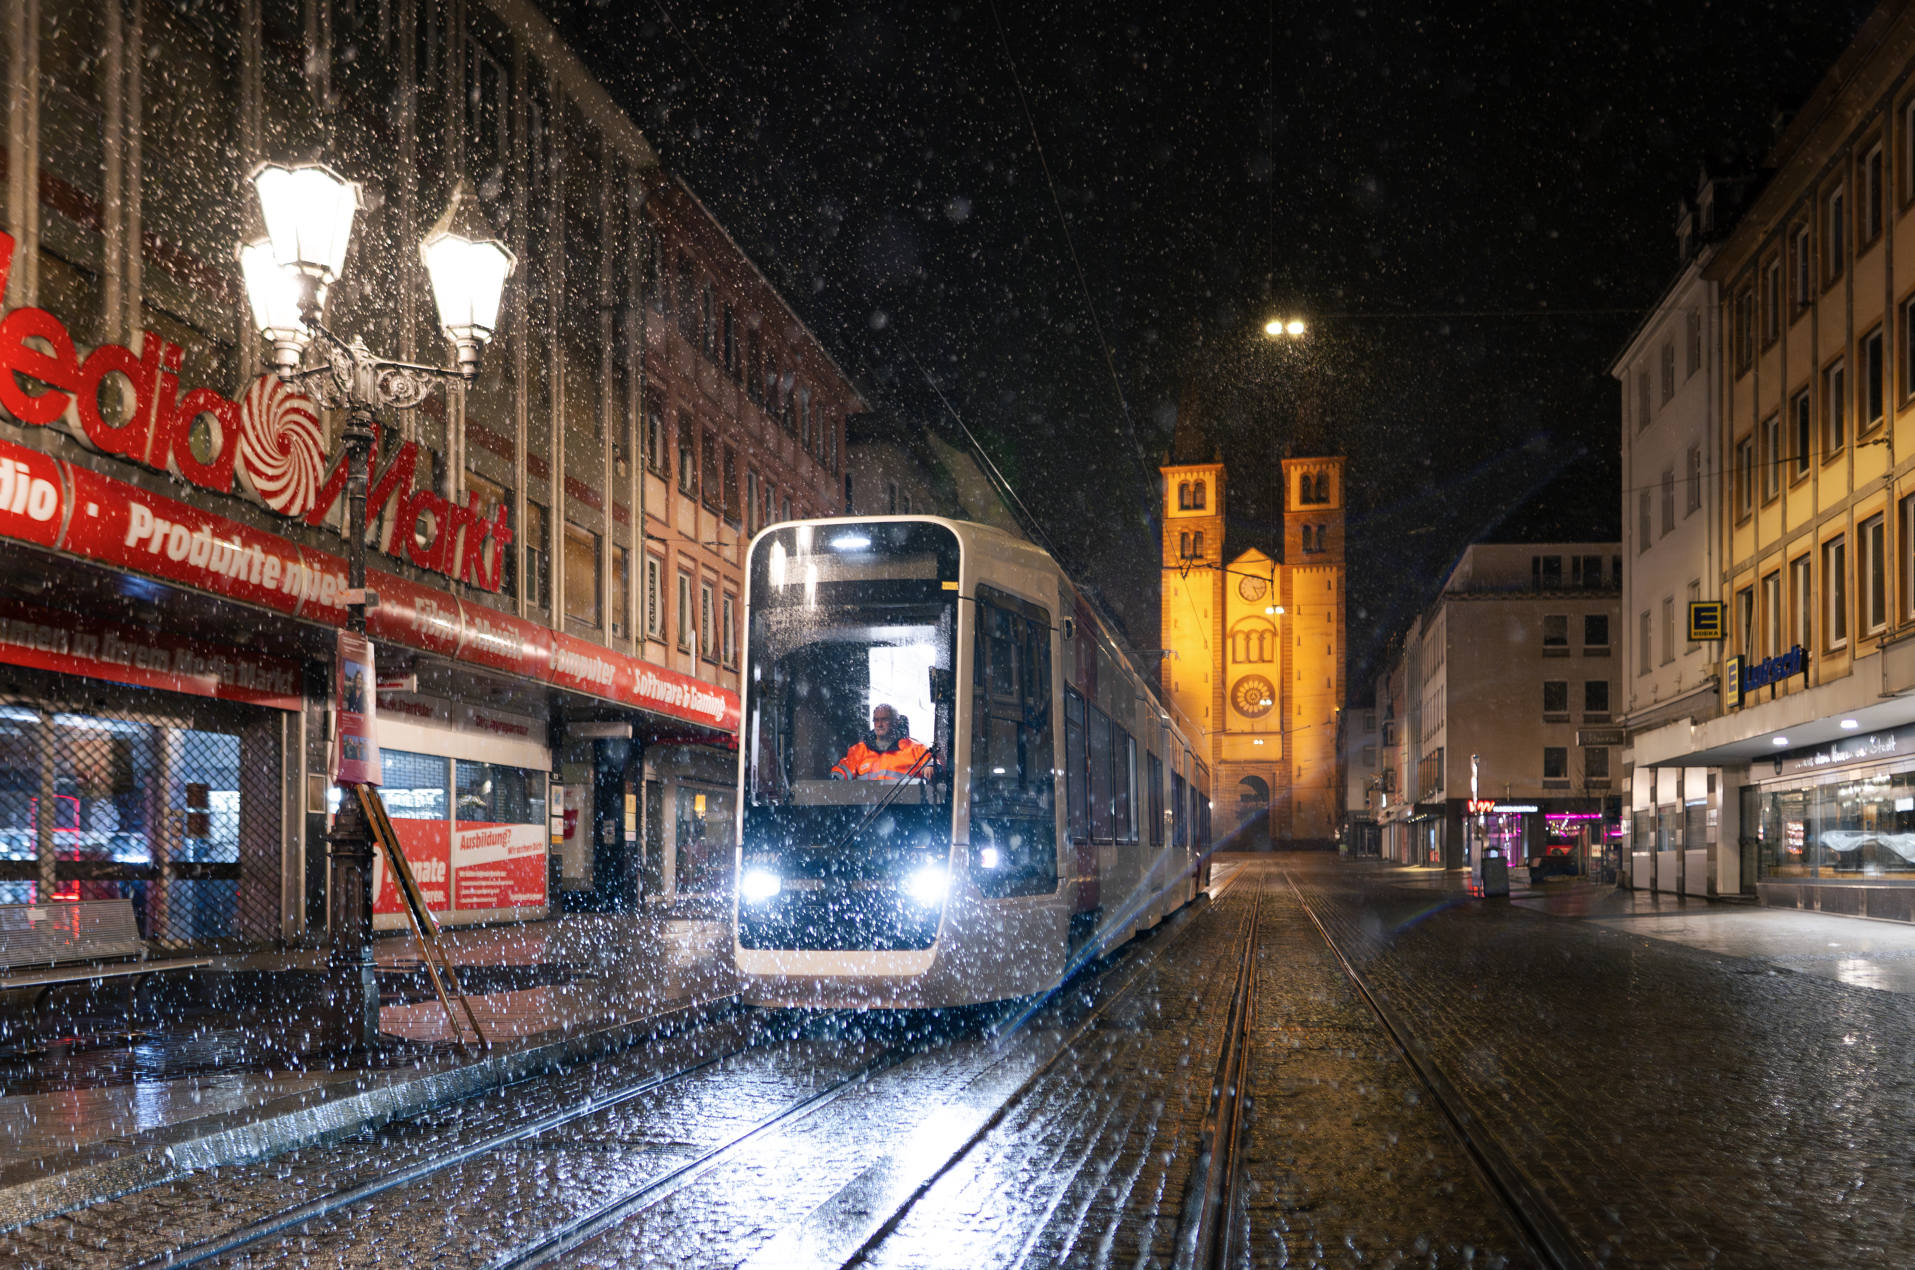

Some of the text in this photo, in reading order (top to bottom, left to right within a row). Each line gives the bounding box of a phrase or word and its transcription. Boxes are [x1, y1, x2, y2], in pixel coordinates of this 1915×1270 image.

[0, 231, 513, 593] edia Markt
[125, 502, 281, 590] Produkte
[411, 596, 455, 641] Film
[472, 617, 525, 661] Musik
[550, 642, 616, 687] Computer
[633, 668, 683, 708] Software
[690, 686, 726, 722] Gaming
[238, 661, 295, 695] Markt
[460, 828, 512, 852] Ausbildung?
[508, 846, 516, 856] Wir
